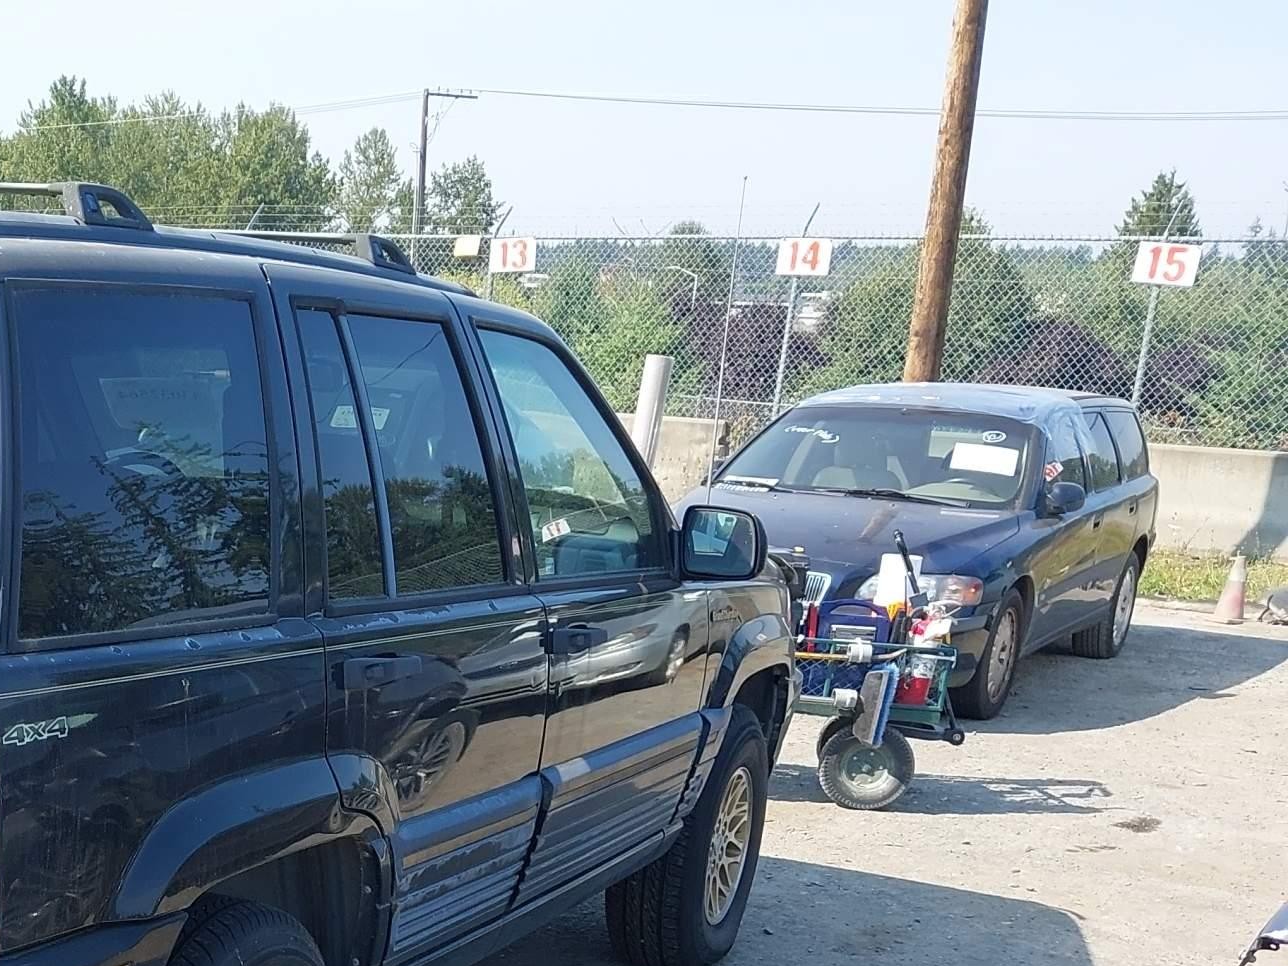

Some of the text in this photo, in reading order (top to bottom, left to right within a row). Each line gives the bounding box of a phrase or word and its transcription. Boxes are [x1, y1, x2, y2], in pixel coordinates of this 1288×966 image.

[500, 239, 528, 269] 13
[790, 240, 820, 271] 14
[1148, 245, 1190, 282] 15
